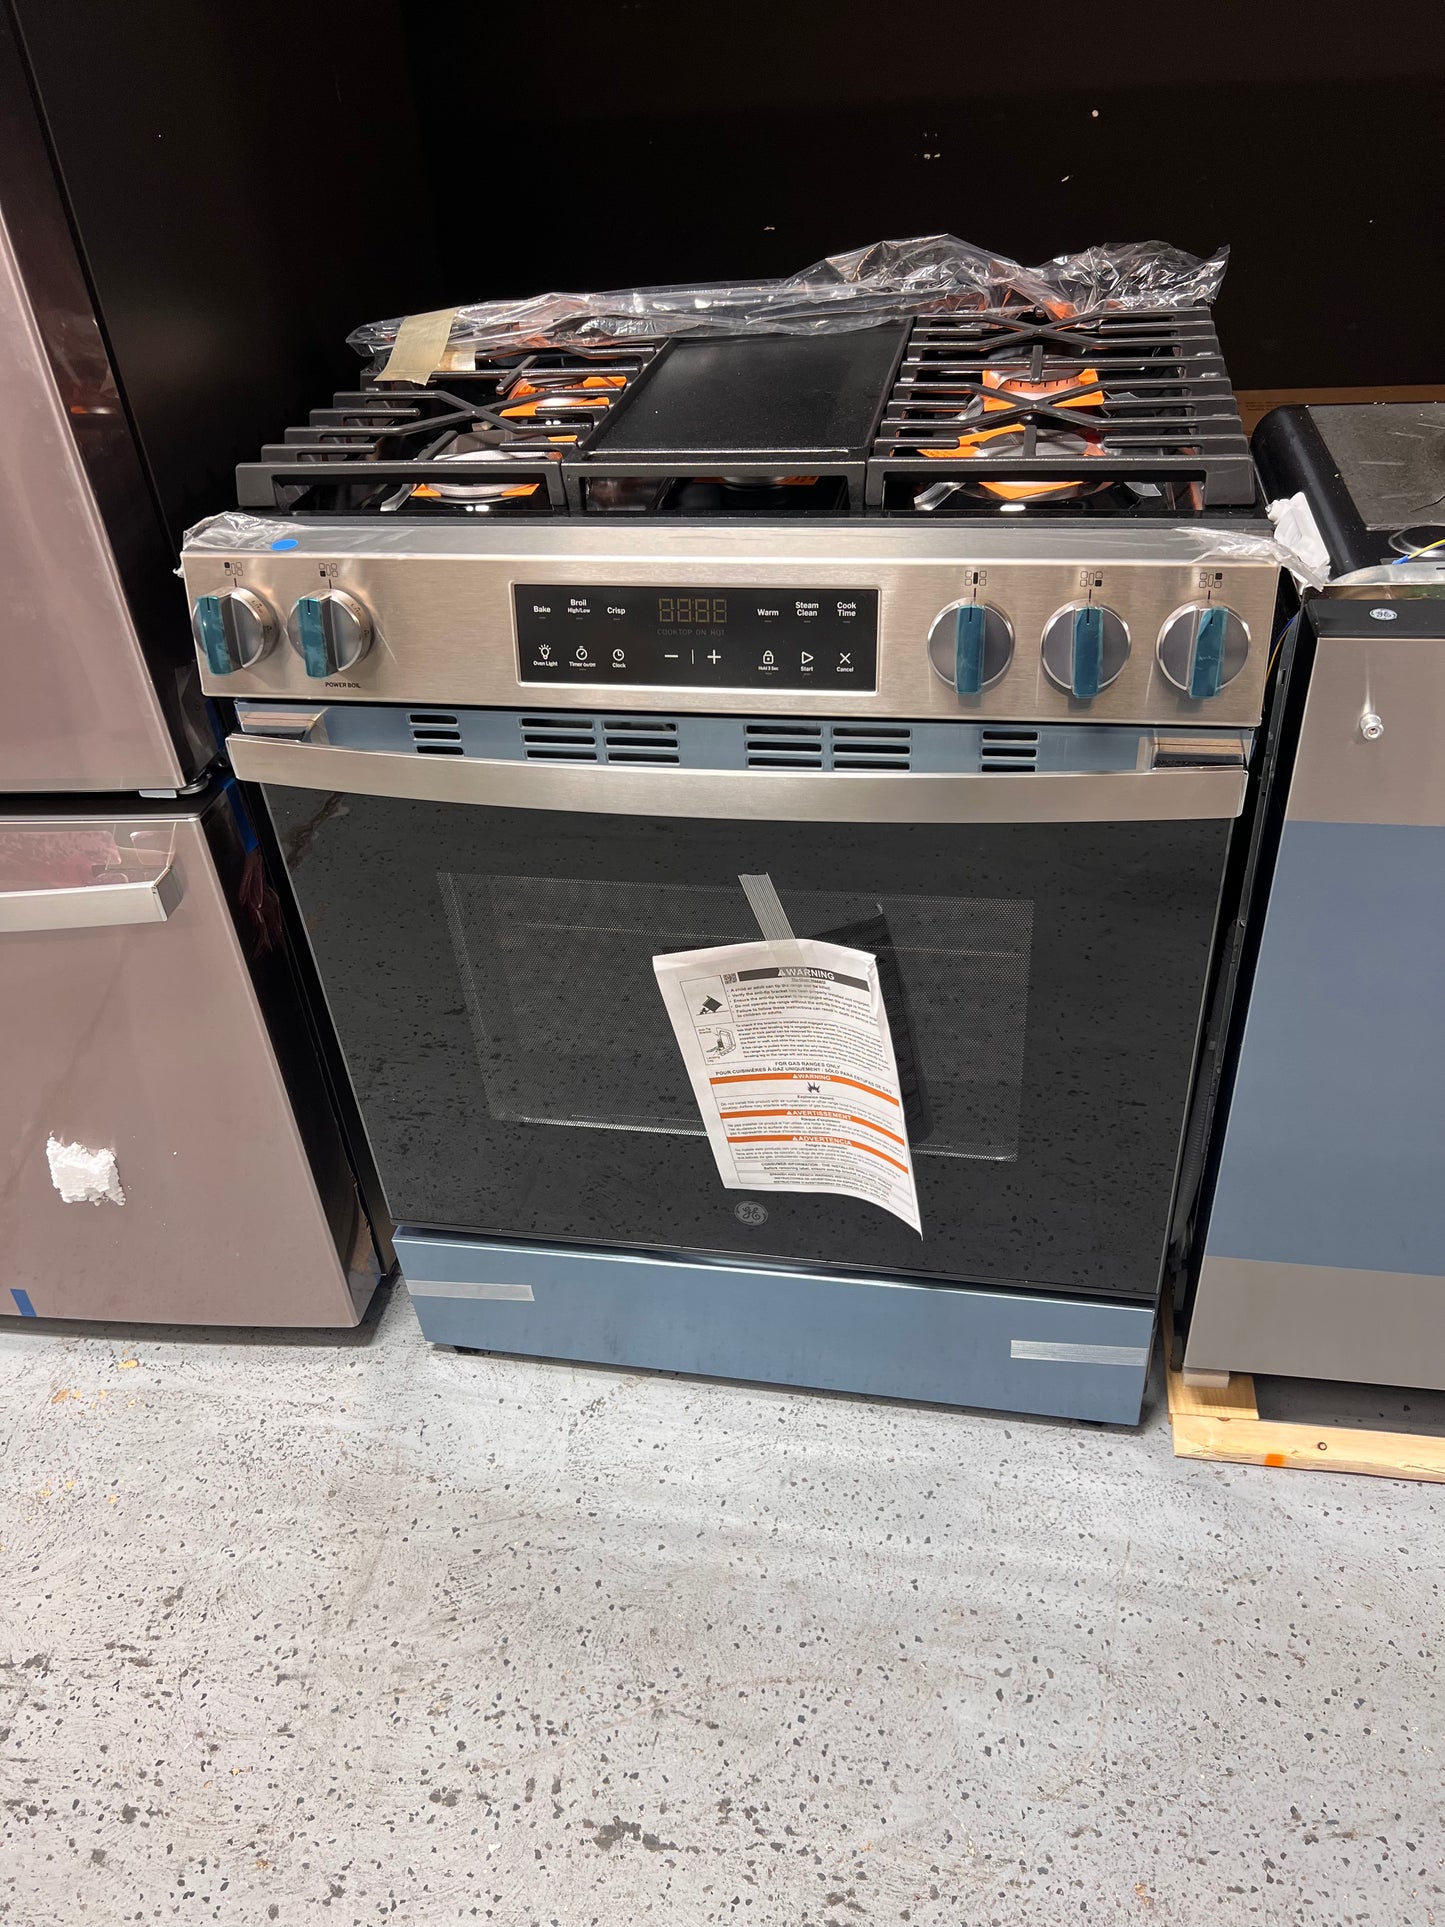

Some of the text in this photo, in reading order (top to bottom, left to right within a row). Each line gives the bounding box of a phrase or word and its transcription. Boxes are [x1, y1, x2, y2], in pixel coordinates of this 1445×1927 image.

[607, 607, 626, 615] Crisp
[757, 609, 779, 617] Warm
[797, 609, 817, 617] Clean
[837, 609, 856, 617] Time
[785, 969, 835, 980] WARNING
[792, 1110, 852, 1121] AVERTISSEMENT
[798, 1135, 852, 1146] ADVERTENCIA
